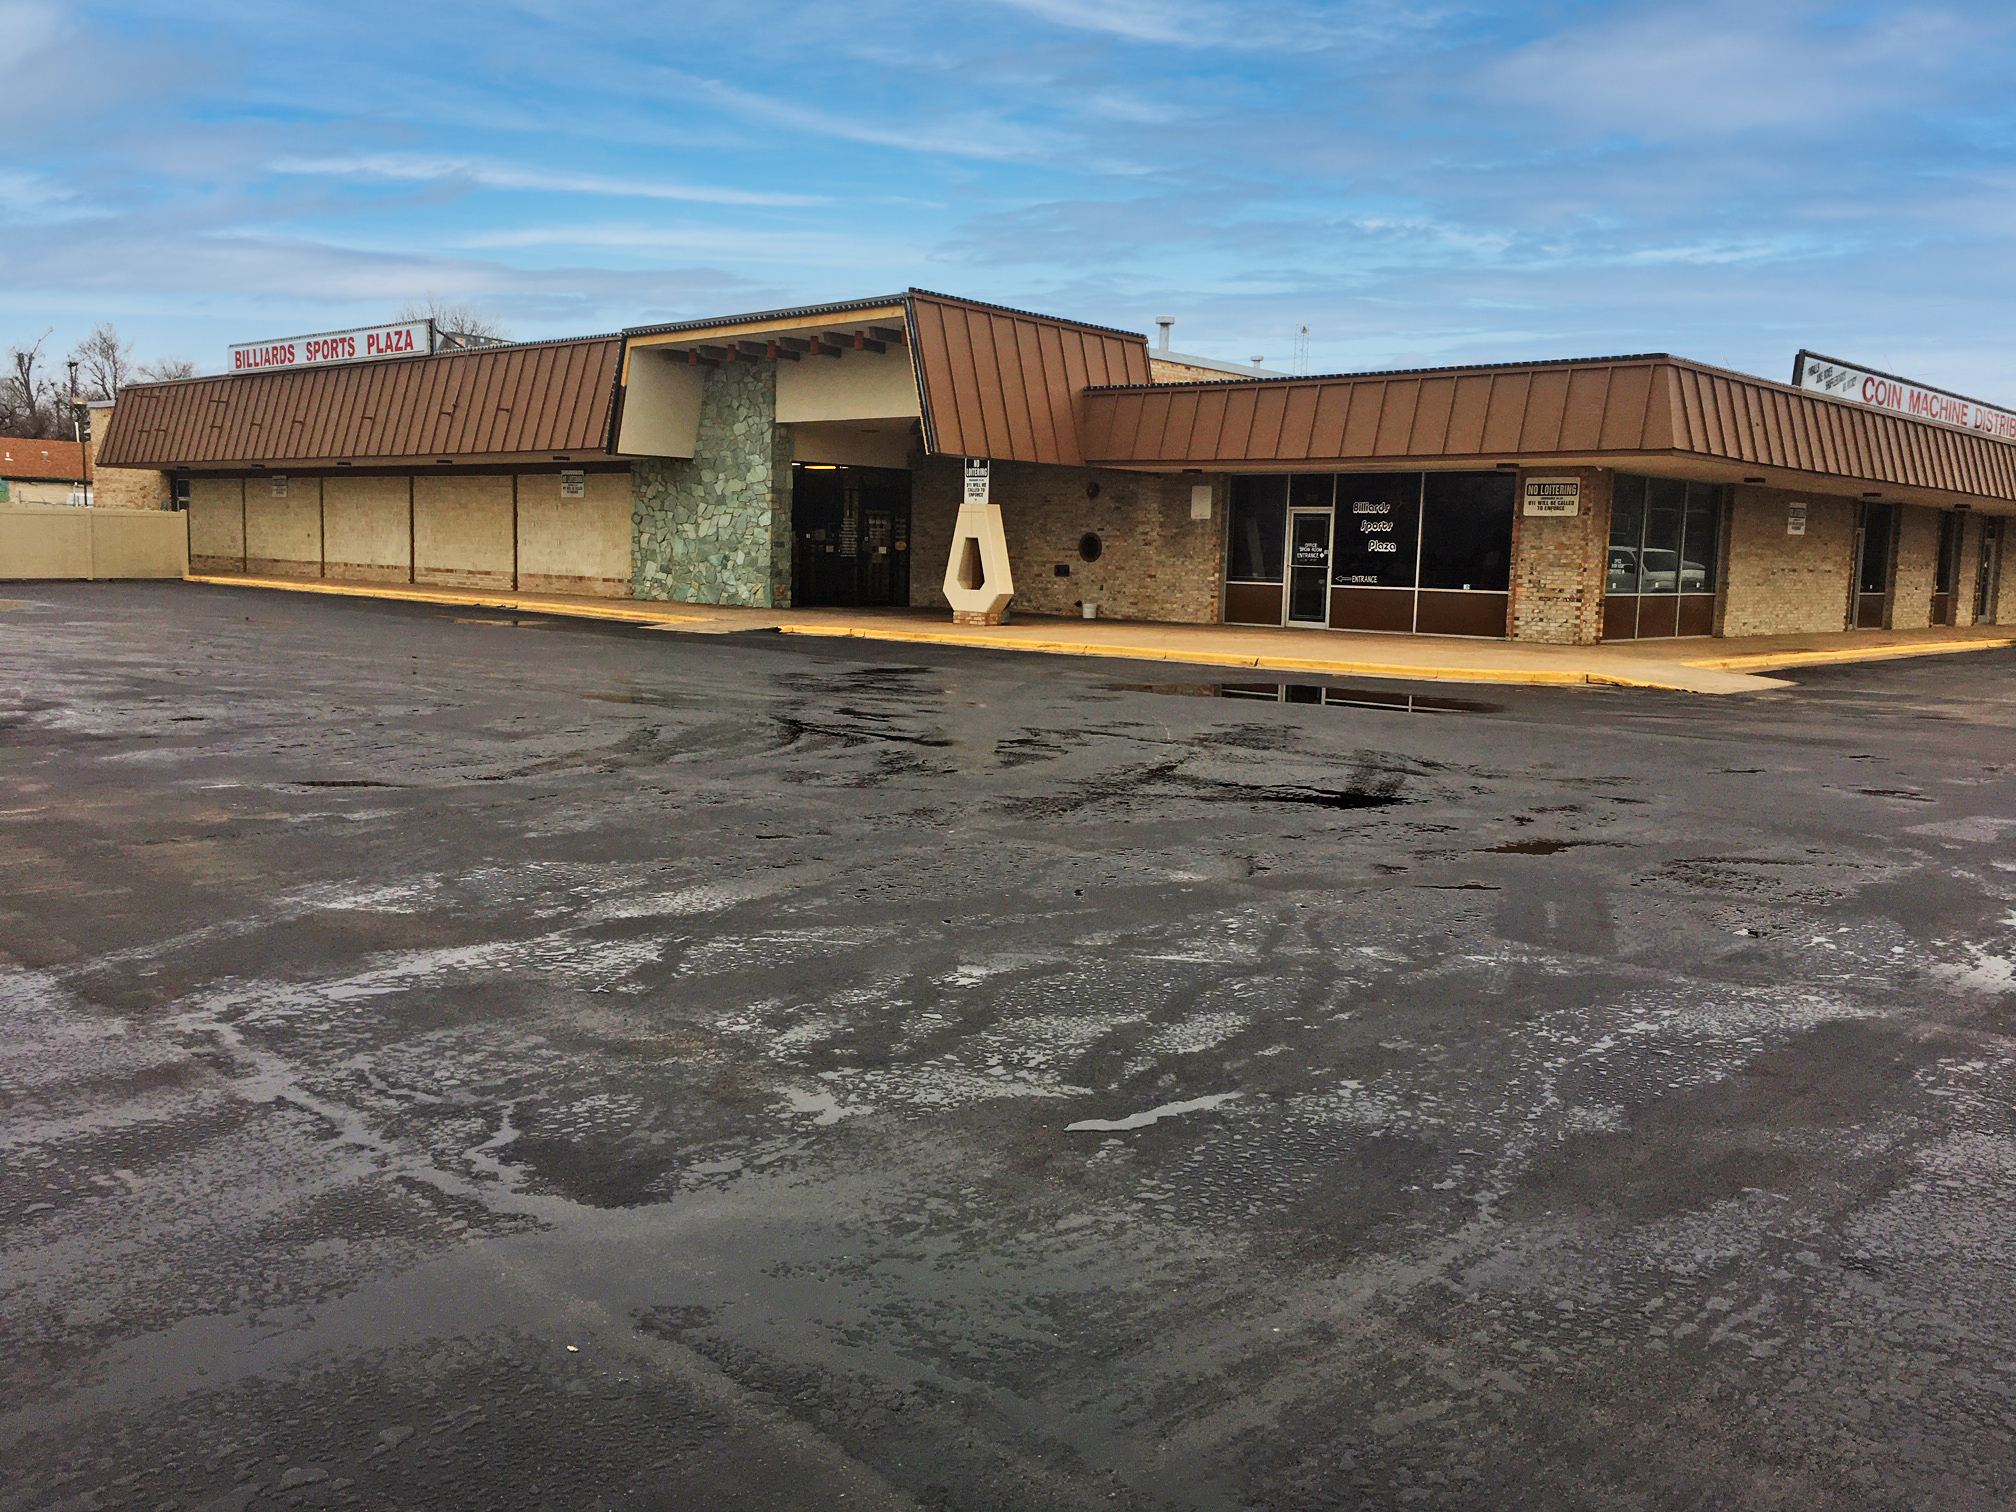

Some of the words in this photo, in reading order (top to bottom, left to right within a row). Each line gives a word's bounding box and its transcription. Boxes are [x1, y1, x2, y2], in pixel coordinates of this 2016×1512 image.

[234, 344, 295, 369] BILLIARDS
[306, 336, 355, 361] SPORTS
[366, 329, 414, 355] PLAZA
[1862, 376, 1902, 410] COIN
[1908, 389, 1968, 426] MACHINE
[966, 468, 987, 476] LOITERING
[1528, 484, 1538, 495] NO
[1540, 484, 1577, 495] LOITERING
[1353, 502, 1390, 514] Billiards
[1360, 519, 1393, 533] Sports
[1368, 539, 1397, 552] Plaza
[1352, 575, 1378, 583] ENTRANCE
